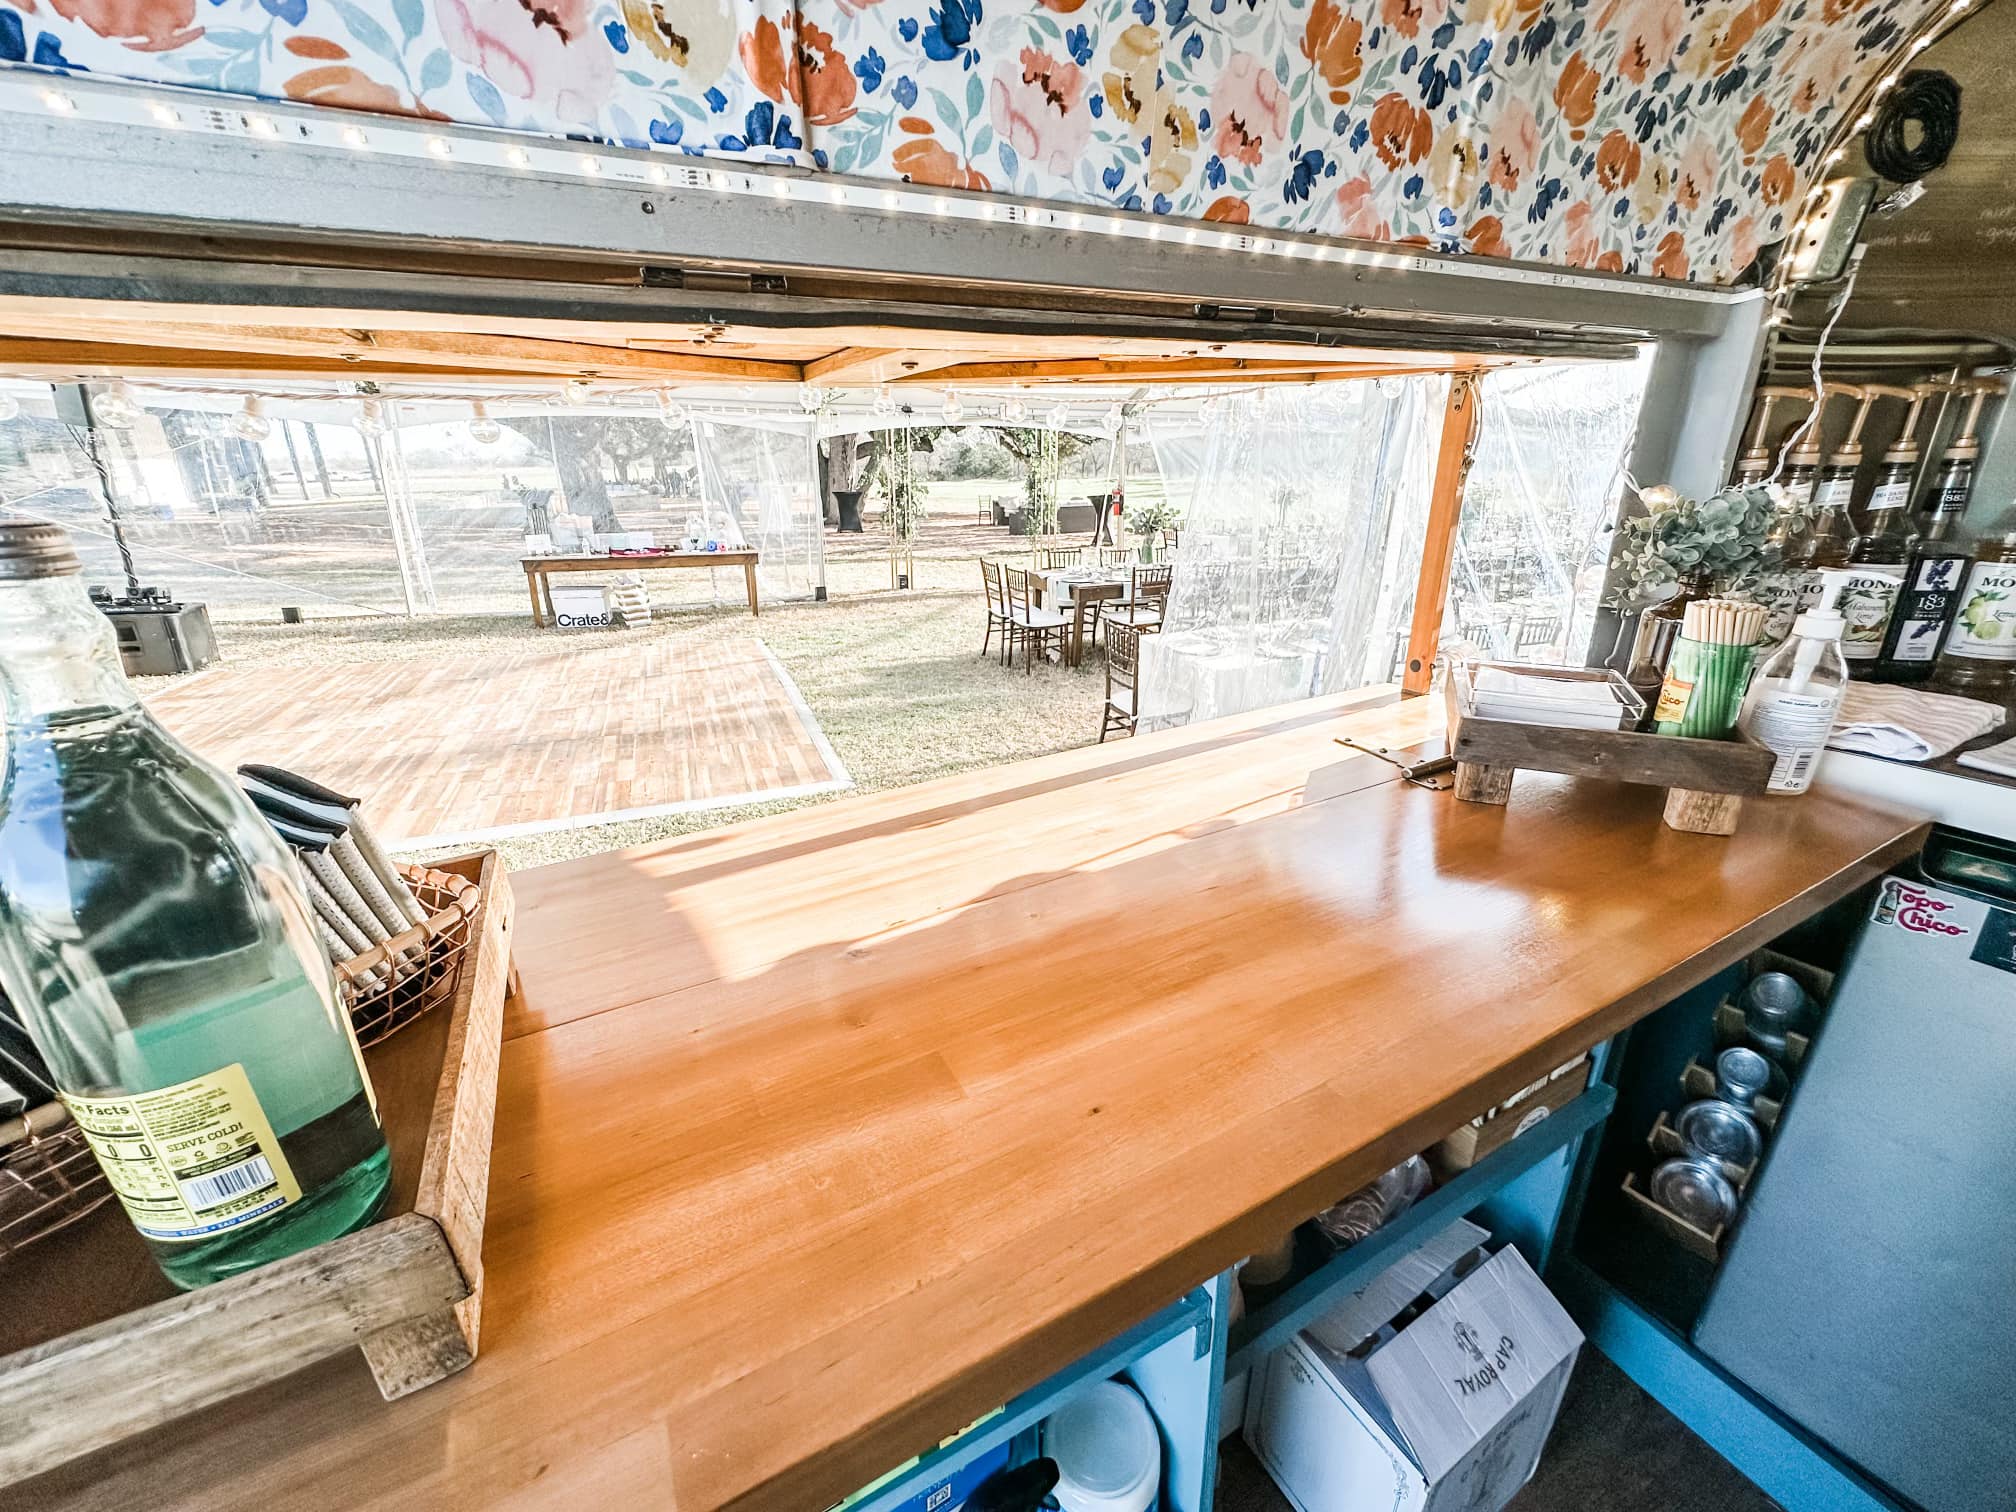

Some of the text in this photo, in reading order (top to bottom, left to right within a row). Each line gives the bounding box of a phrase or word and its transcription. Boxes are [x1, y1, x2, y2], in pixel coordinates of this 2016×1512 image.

[558, 613, 608, 627] Crate&
[1898, 907, 1968, 935] Chico
[86, 1104, 129, 1116] Facts
[166, 1121, 244, 1153] SERVE COLD!
[1453, 1335, 1515, 1396] CAP ROYAL
